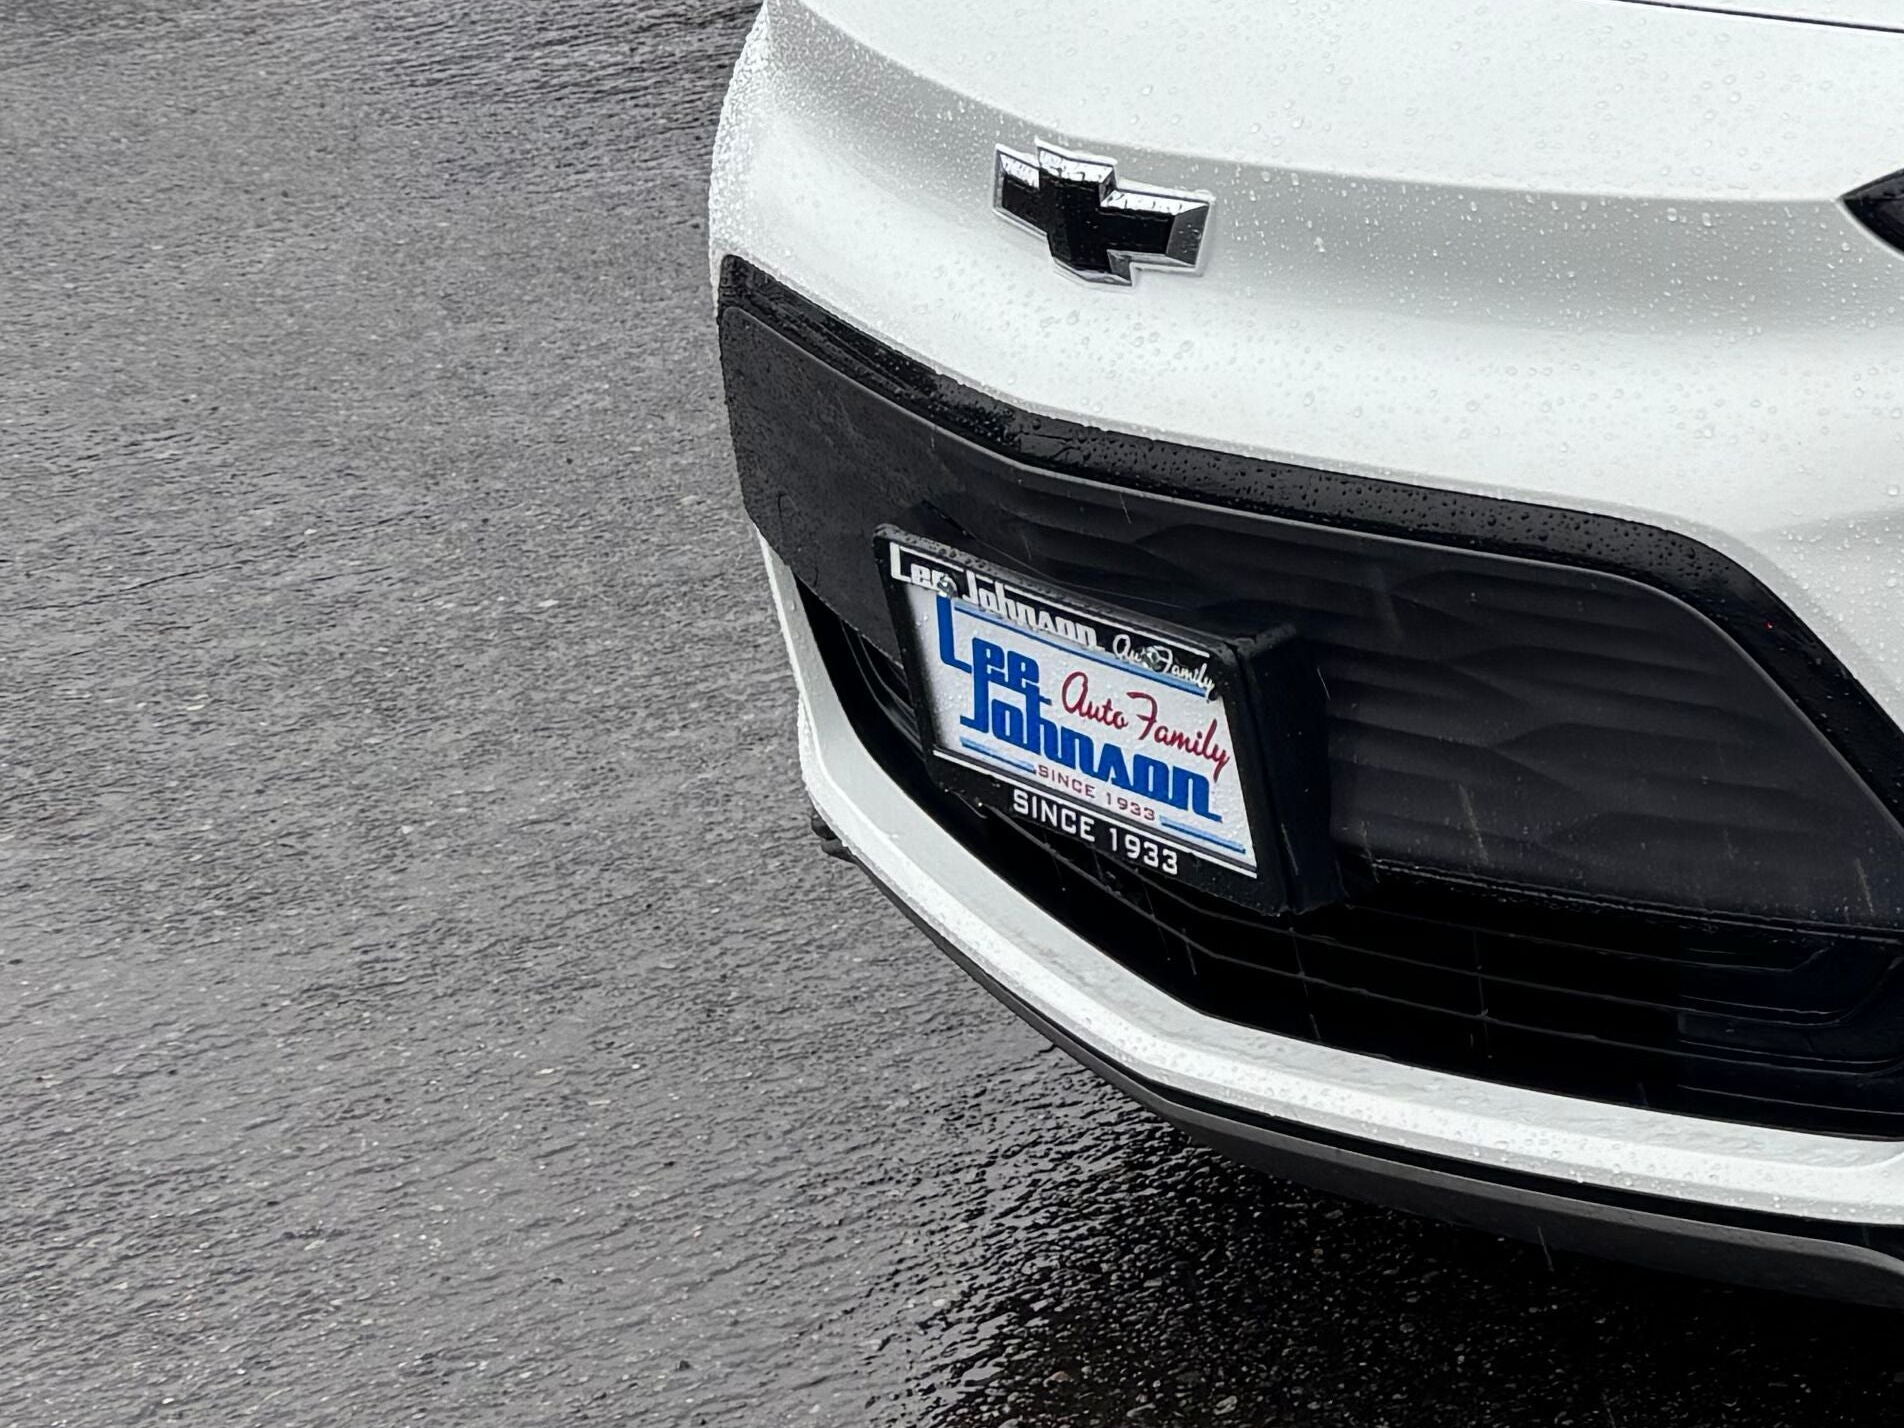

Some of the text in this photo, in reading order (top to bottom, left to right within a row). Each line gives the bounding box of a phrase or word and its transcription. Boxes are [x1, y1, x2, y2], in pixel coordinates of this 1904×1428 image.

[936, 595, 1052, 706] Lee
[962, 571, 1105, 652] Johnson
[1112, 633, 1160, 669] Au
[960, 678, 1222, 823] Johnson
[1061, 671, 1230, 782] Auto Family
[1012, 788, 1179, 875] SINCE 1933
[1038, 764, 1156, 822] SINCE 1933
